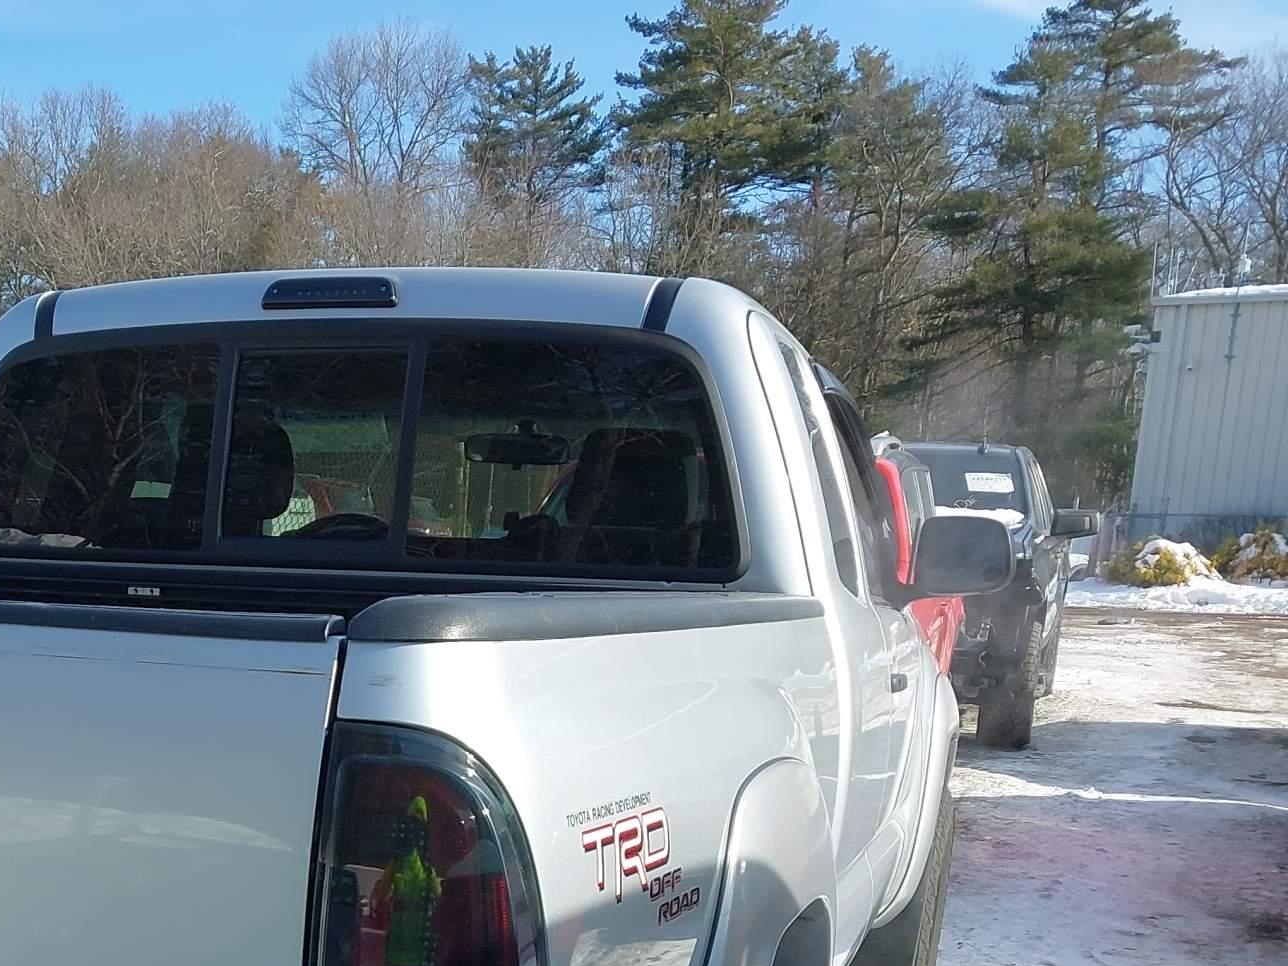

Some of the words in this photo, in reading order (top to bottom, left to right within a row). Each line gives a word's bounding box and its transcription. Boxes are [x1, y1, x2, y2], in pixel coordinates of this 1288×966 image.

[566, 810, 592, 828] TOYOTA
[592, 803, 615, 820] RACING
[615, 792, 651, 814] DEVELOPMENT
[581, 806, 671, 904] TRD
[649, 867, 682, 902] OFF
[657, 887, 701, 927] ROAD
